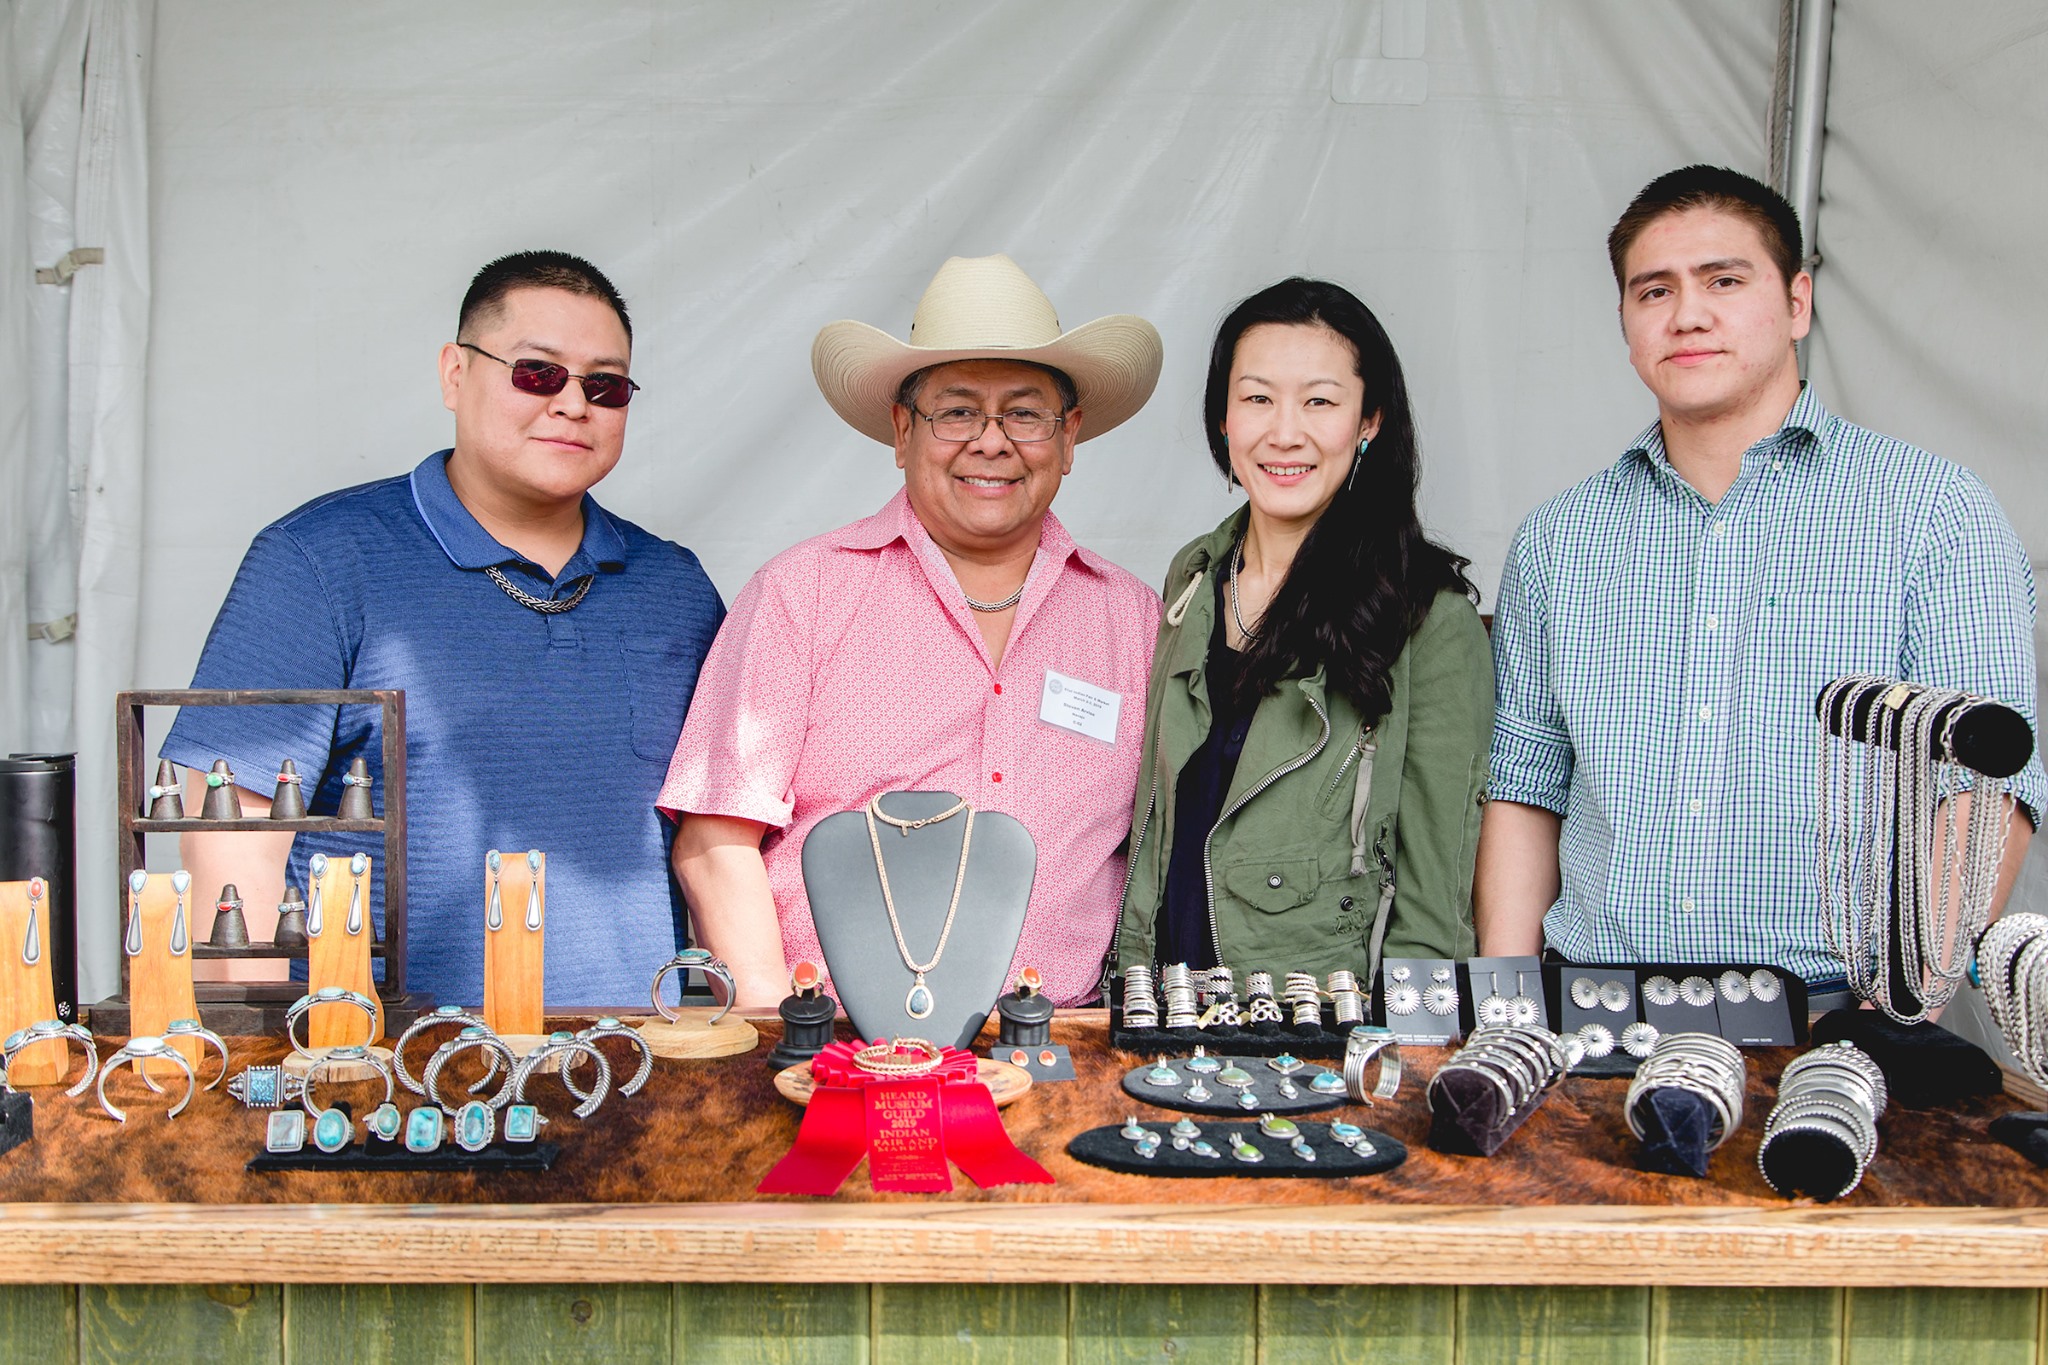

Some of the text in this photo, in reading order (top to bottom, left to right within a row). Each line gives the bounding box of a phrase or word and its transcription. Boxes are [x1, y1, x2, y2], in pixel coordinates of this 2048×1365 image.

[880, 1091, 928, 1100] HEARD
[874, 1099, 933, 1110] MUSEUM
[882, 1110, 926, 1120] GUILD
[891, 1119, 917, 1128] 2019
[880, 1128, 930, 1138] INDIAN
